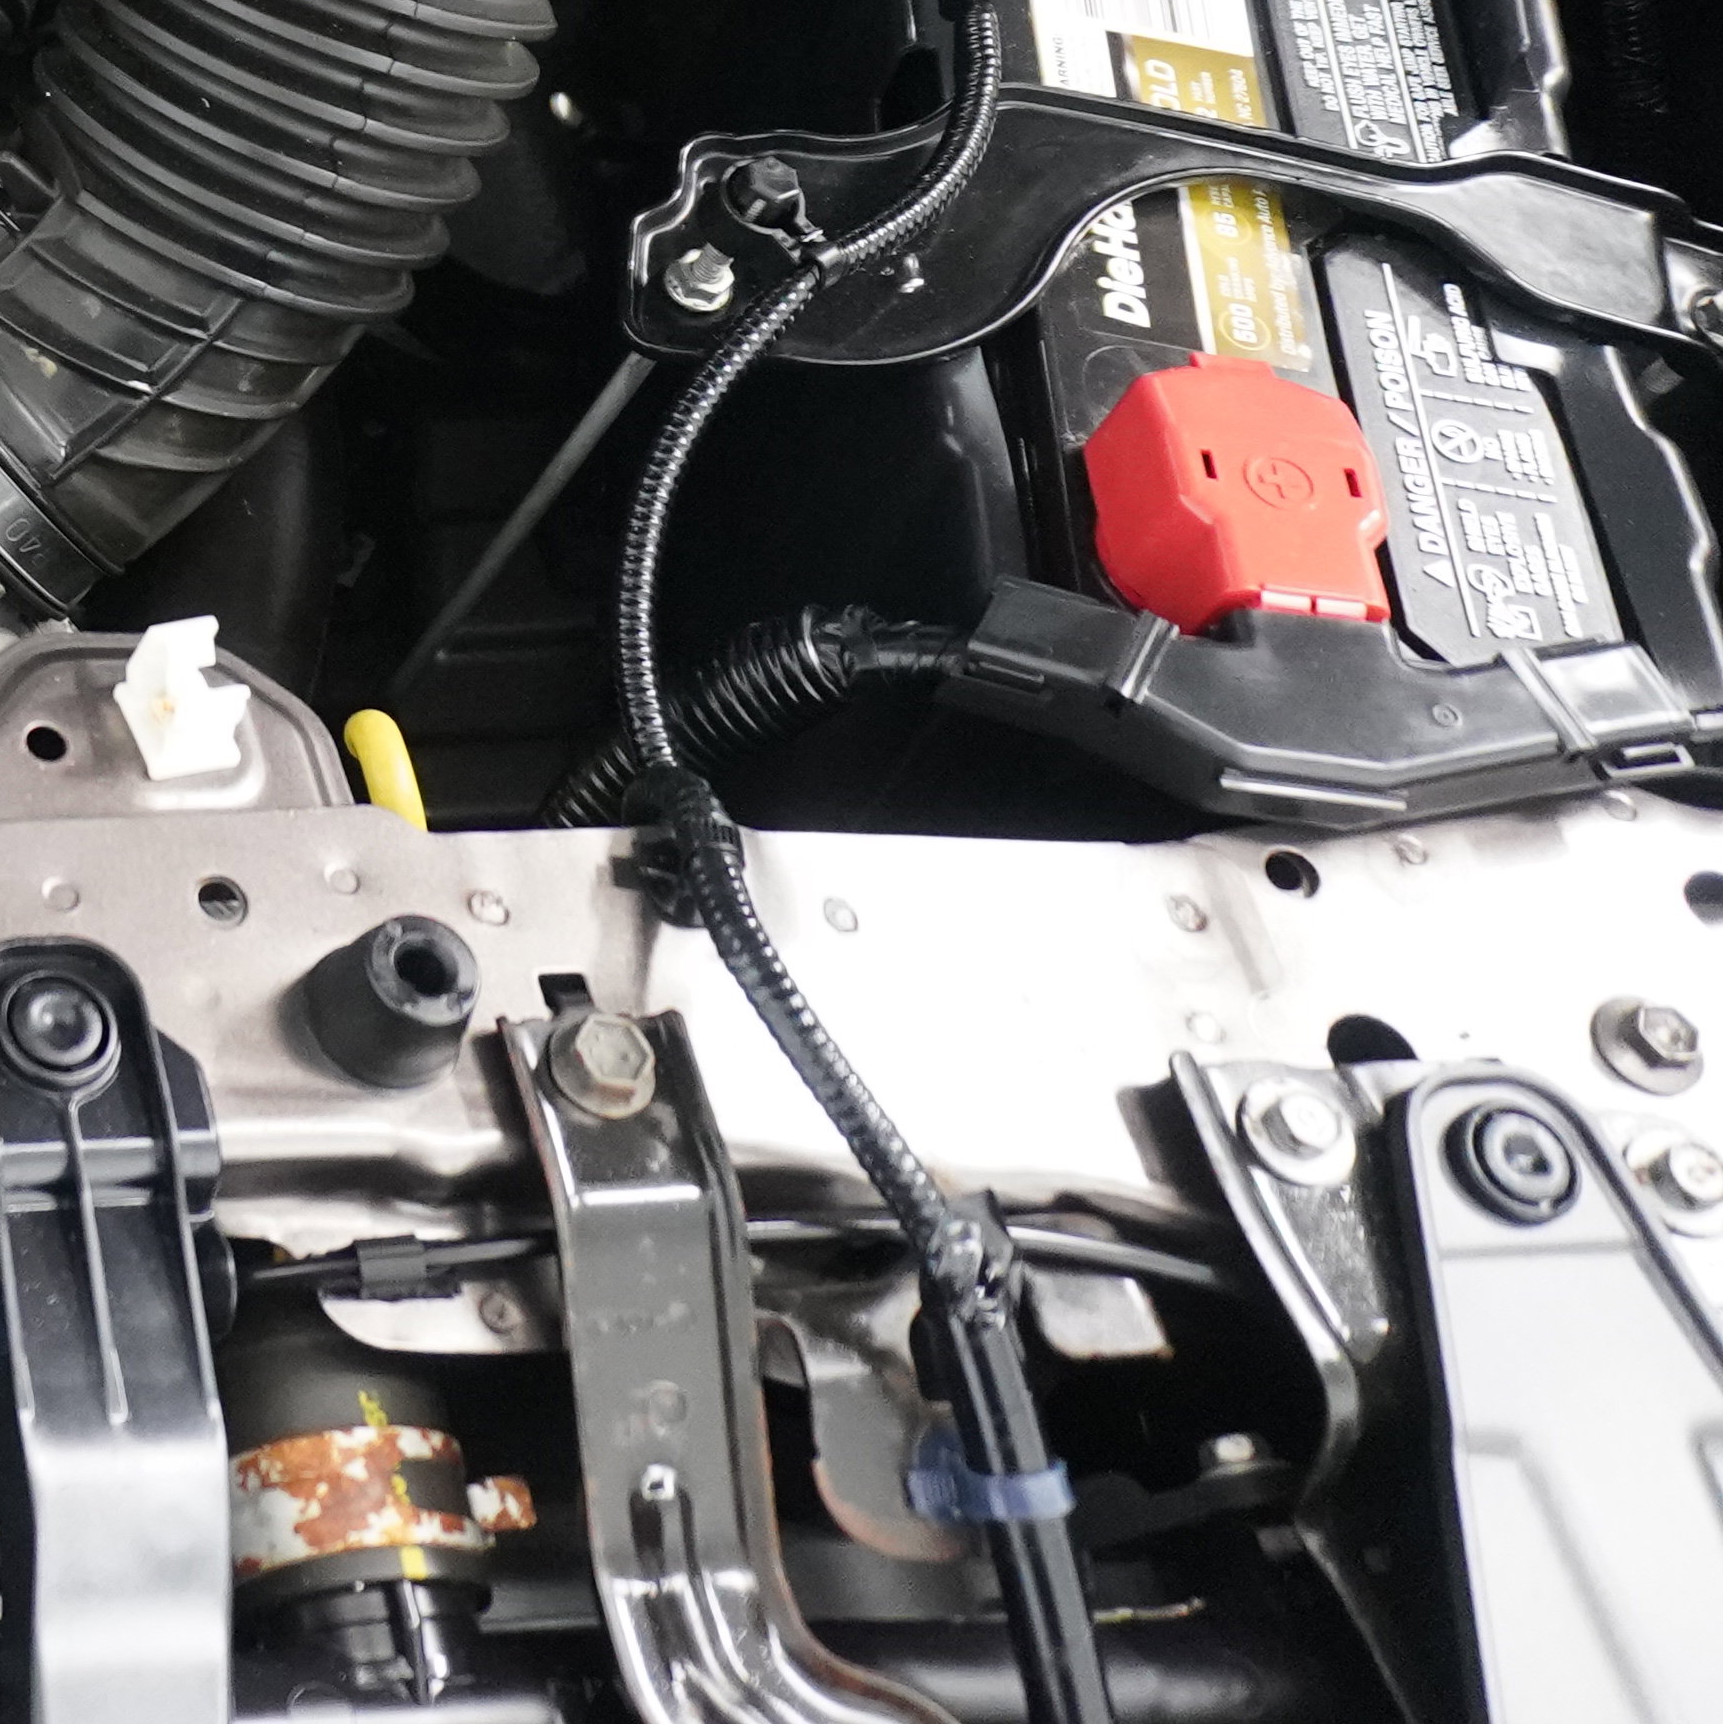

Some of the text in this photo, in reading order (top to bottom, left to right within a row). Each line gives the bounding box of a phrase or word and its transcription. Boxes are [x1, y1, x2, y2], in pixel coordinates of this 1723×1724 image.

[1348, 13, 1371, 40] GET
[1336, 44, 1361, 77] EYES
[1362, 3, 1408, 125] MEDICAL HELP FAST
[1344, 77, 1372, 119] FLUSH
[1364, 88, 1390, 121] WITH
[1089, 199, 1152, 329] DieHa
[1442, 282, 1470, 317] ACID
[1362, 308, 1416, 413] POISON
[1394, 436, 1452, 557] DANGER
